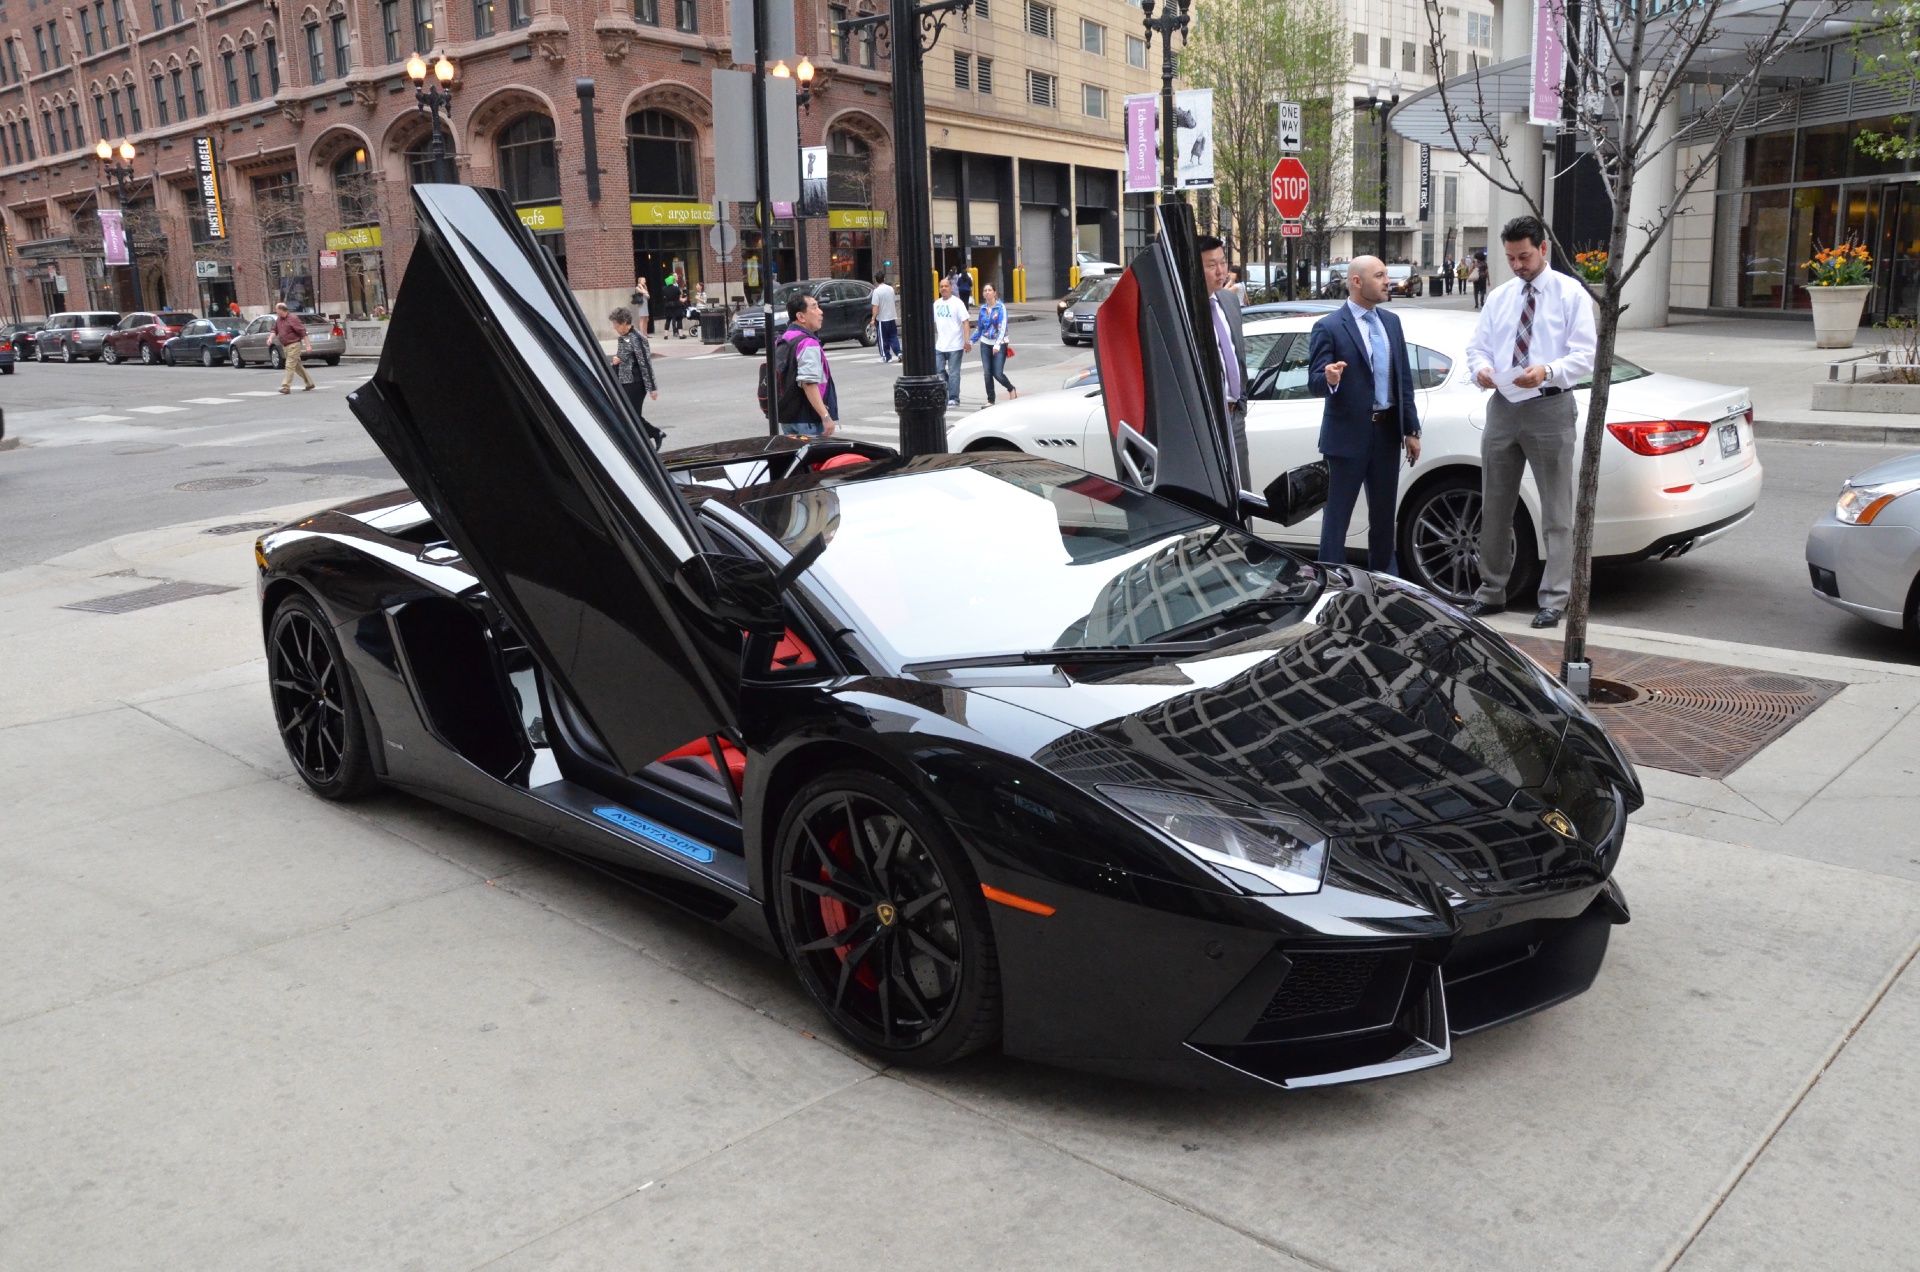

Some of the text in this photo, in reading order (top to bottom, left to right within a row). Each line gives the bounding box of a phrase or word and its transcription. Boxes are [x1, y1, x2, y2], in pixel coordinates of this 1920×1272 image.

[1541, 36, 1553, 87] Gorey
[1281, 106, 1298, 118] ONE
[1138, 108, 1147, 143] Edward
[1282, 120, 1298, 132] WAY
[1136, 143, 1147, 171] Gorey
[197, 138, 220, 237] EINSTEIN BROS. BAGELS
[1274, 177, 1307, 200] STOP
[1420, 187, 1429, 209] rack
[521, 209, 545, 226] café
[668, 208, 689, 223] argo
[690, 208, 702, 220] tea
[348, 230, 368, 244] café
[1283, 226, 1300, 234] ALL WAY
[611, 813, 700, 853] AVENTADOR
